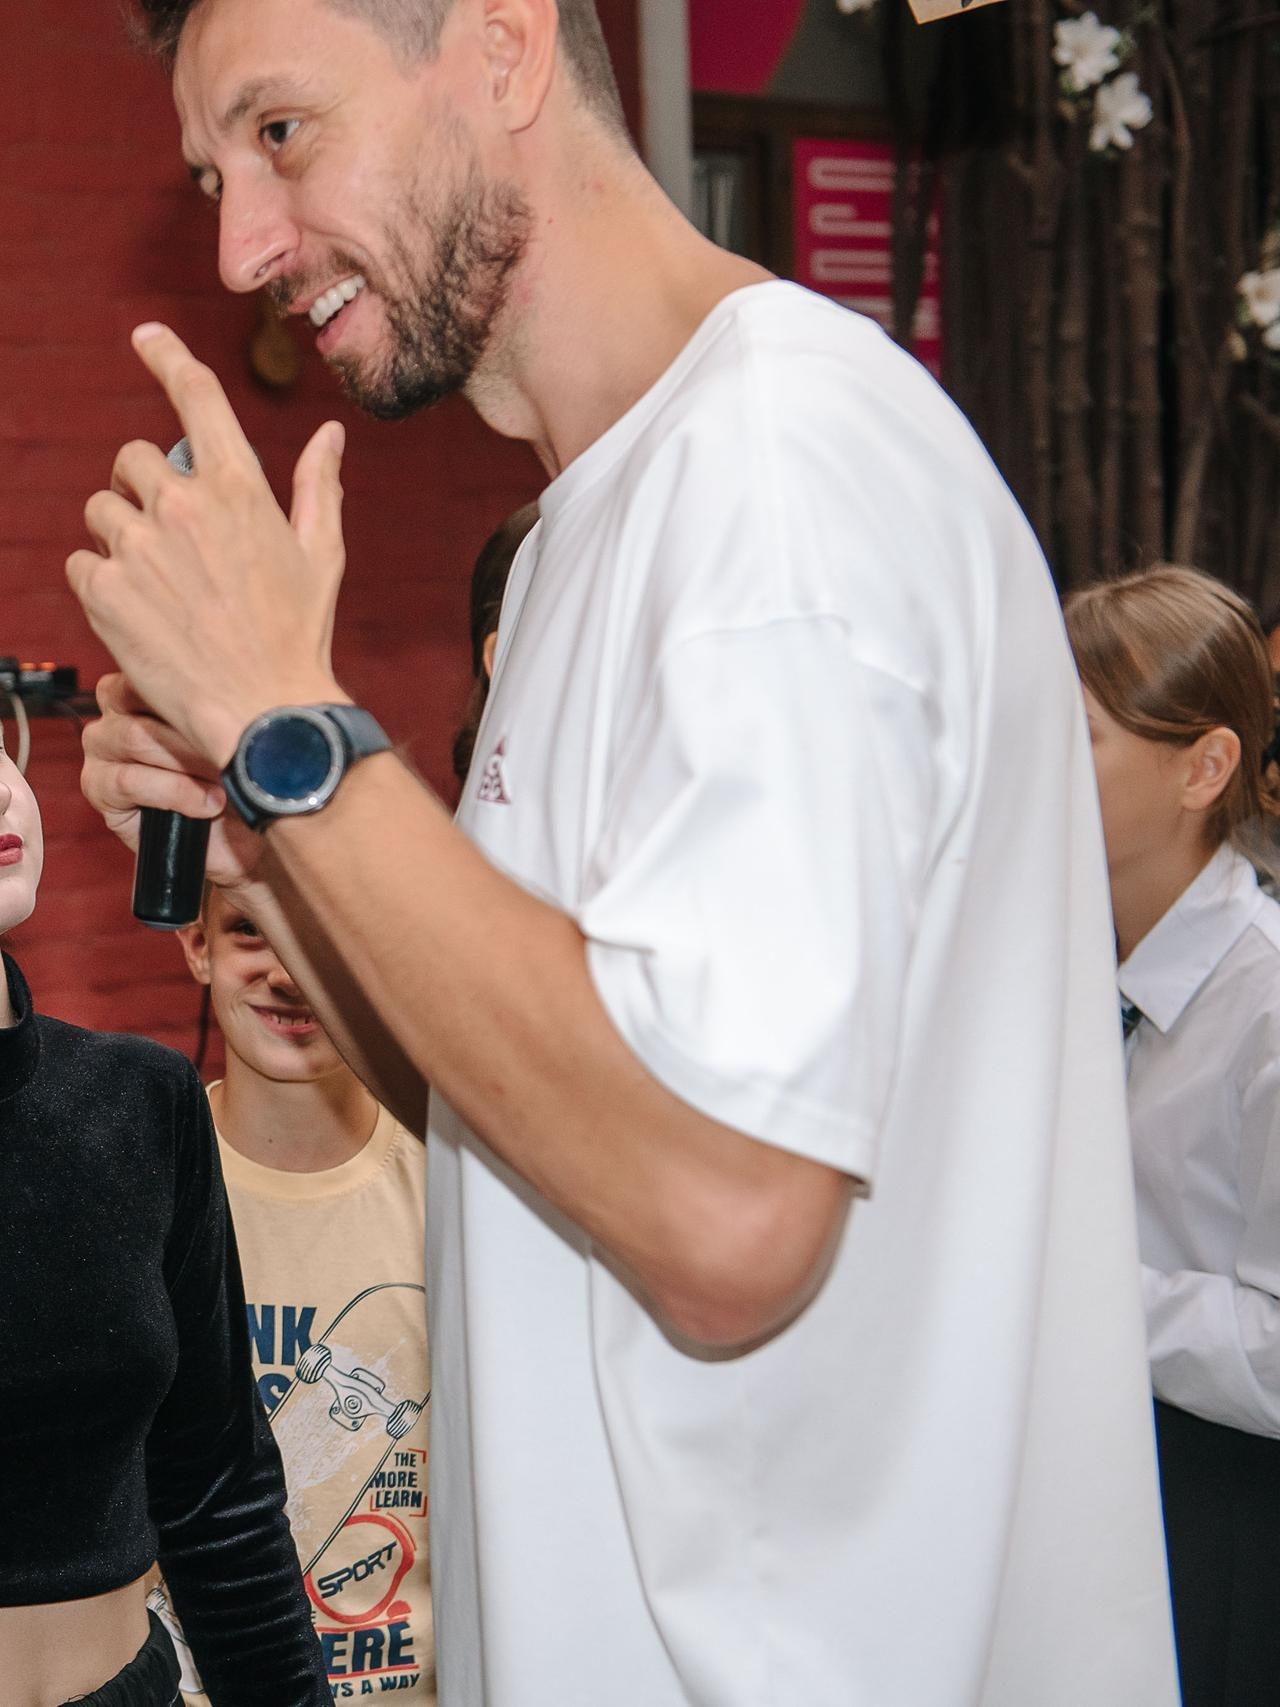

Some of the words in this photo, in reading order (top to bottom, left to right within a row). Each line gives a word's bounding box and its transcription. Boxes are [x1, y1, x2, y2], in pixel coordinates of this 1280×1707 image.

[394, 1452, 417, 1468] THE
[369, 1470, 418, 1489] MORE
[375, 1489, 423, 1508] LEARN
[317, 1540, 398, 1599] SPORT
[320, 1621, 416, 1675] ERE
[361, 1679, 373, 1695] A
[379, 1672, 420, 1692] WAY
